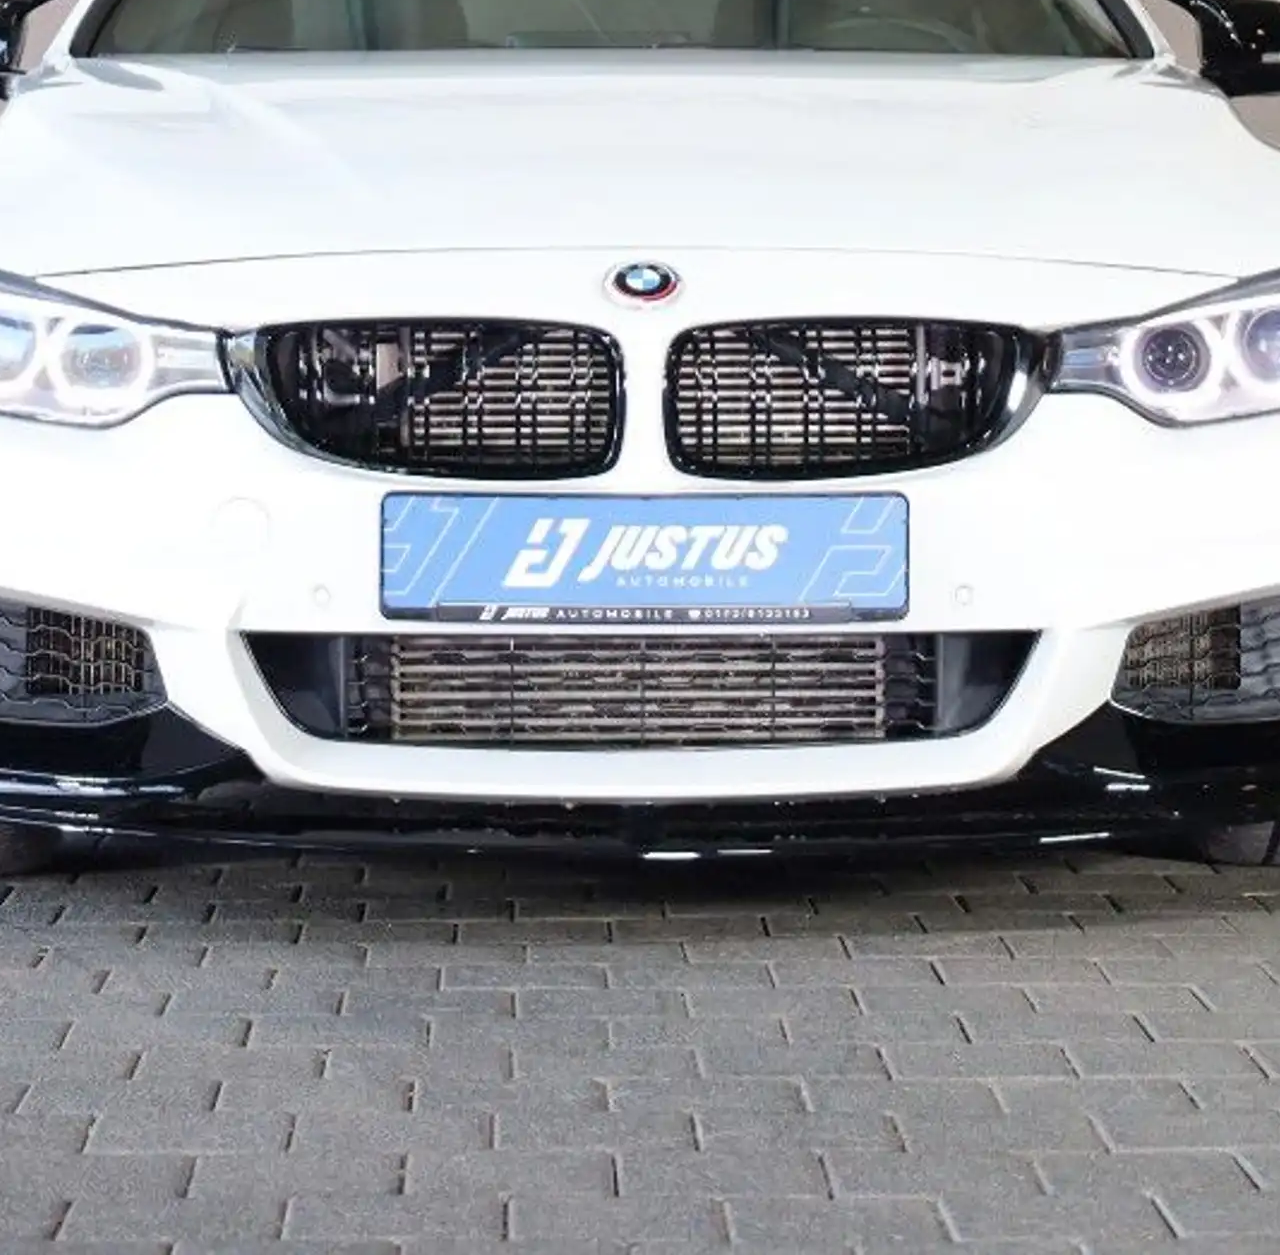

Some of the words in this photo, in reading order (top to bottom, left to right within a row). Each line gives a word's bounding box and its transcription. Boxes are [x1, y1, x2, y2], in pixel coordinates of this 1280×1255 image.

[577, 524, 789, 582] JUSTUS
[616, 575, 749, 587] AUTOMOBILE
[555, 609, 673, 619] AUTOMOBILE
